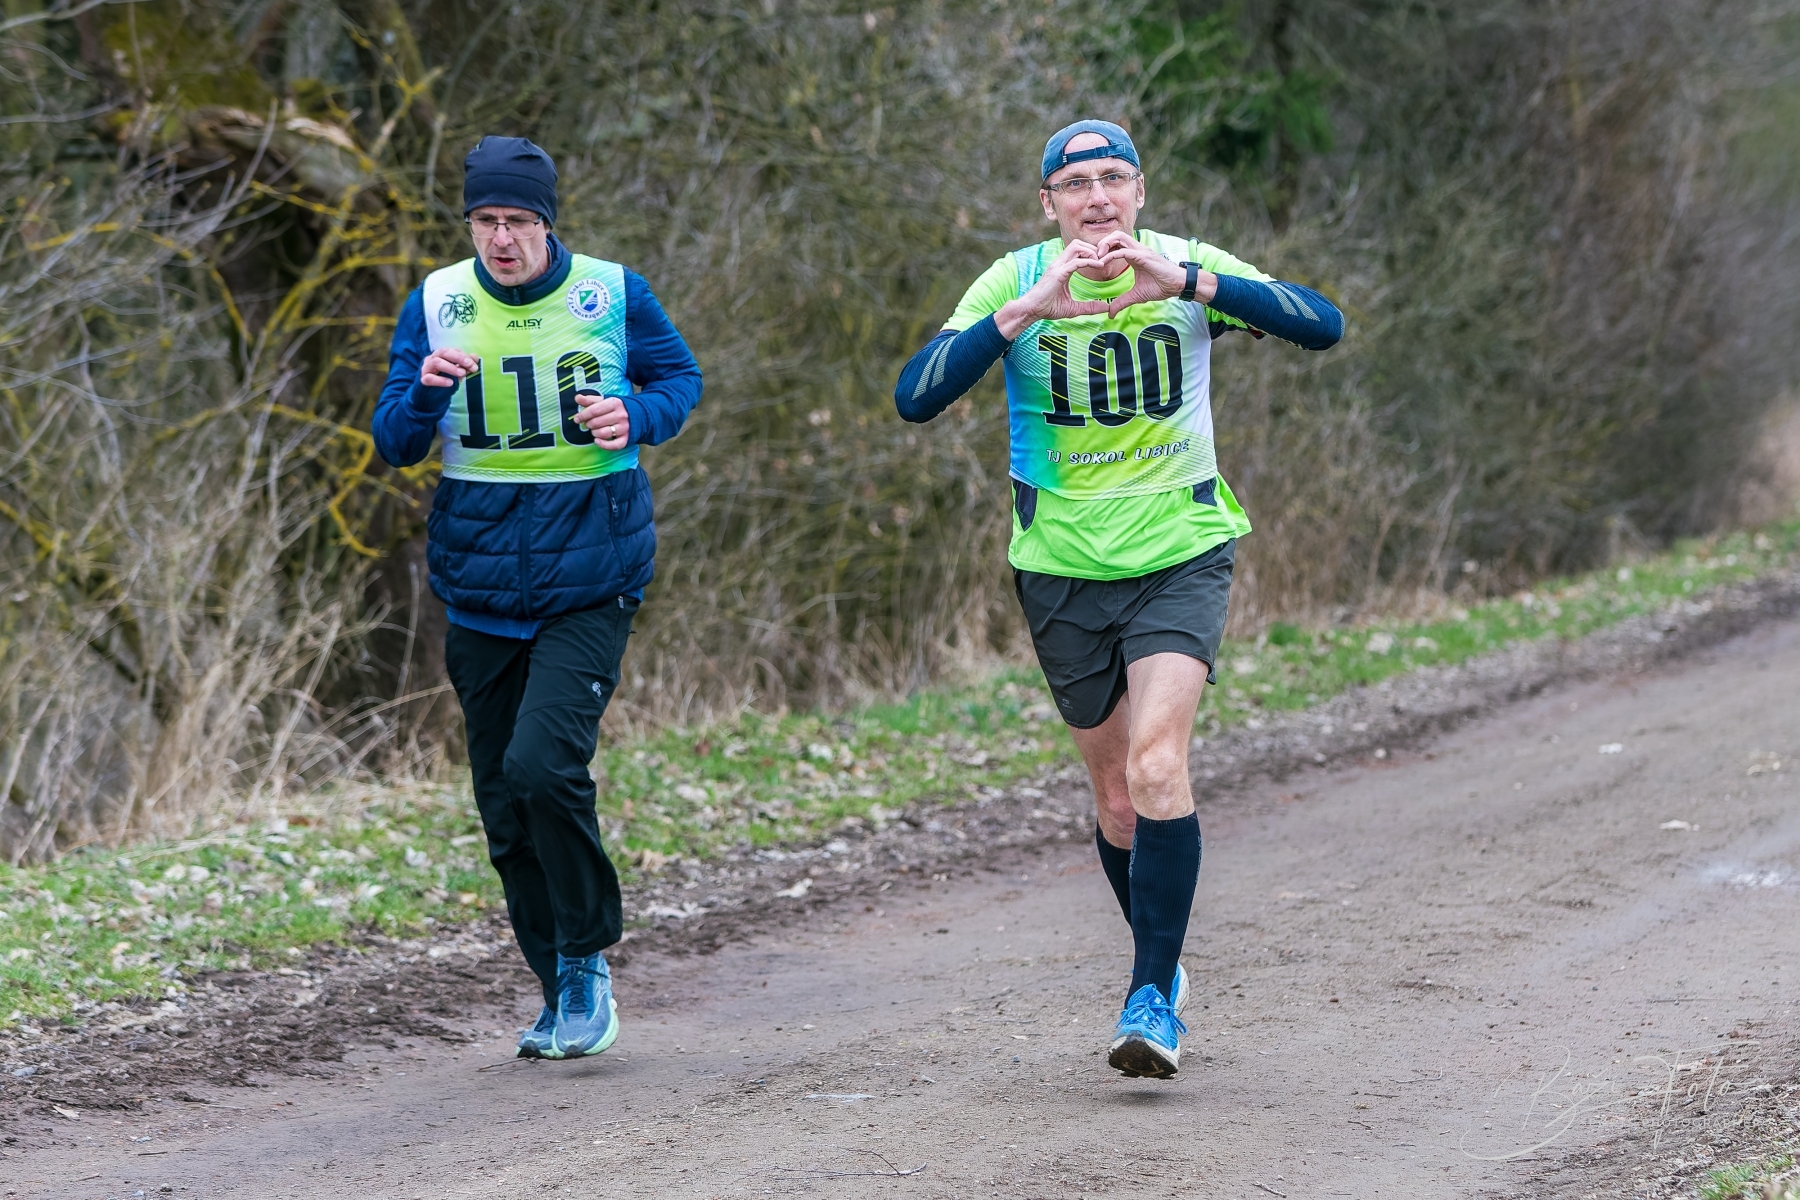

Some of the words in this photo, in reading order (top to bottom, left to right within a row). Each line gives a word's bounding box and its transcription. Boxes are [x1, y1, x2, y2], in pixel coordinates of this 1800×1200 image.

[570, 281, 584, 296] Sokol
[586, 279, 605, 291] Libice
[506, 318, 543, 328] ALISY
[1037, 323, 1184, 428] 100
[459, 350, 604, 450] 116
[1046, 449, 1061, 463] TJ
[1068, 451, 1127, 464] SOKOL
[1134, 438, 1190, 460] LIBICE
